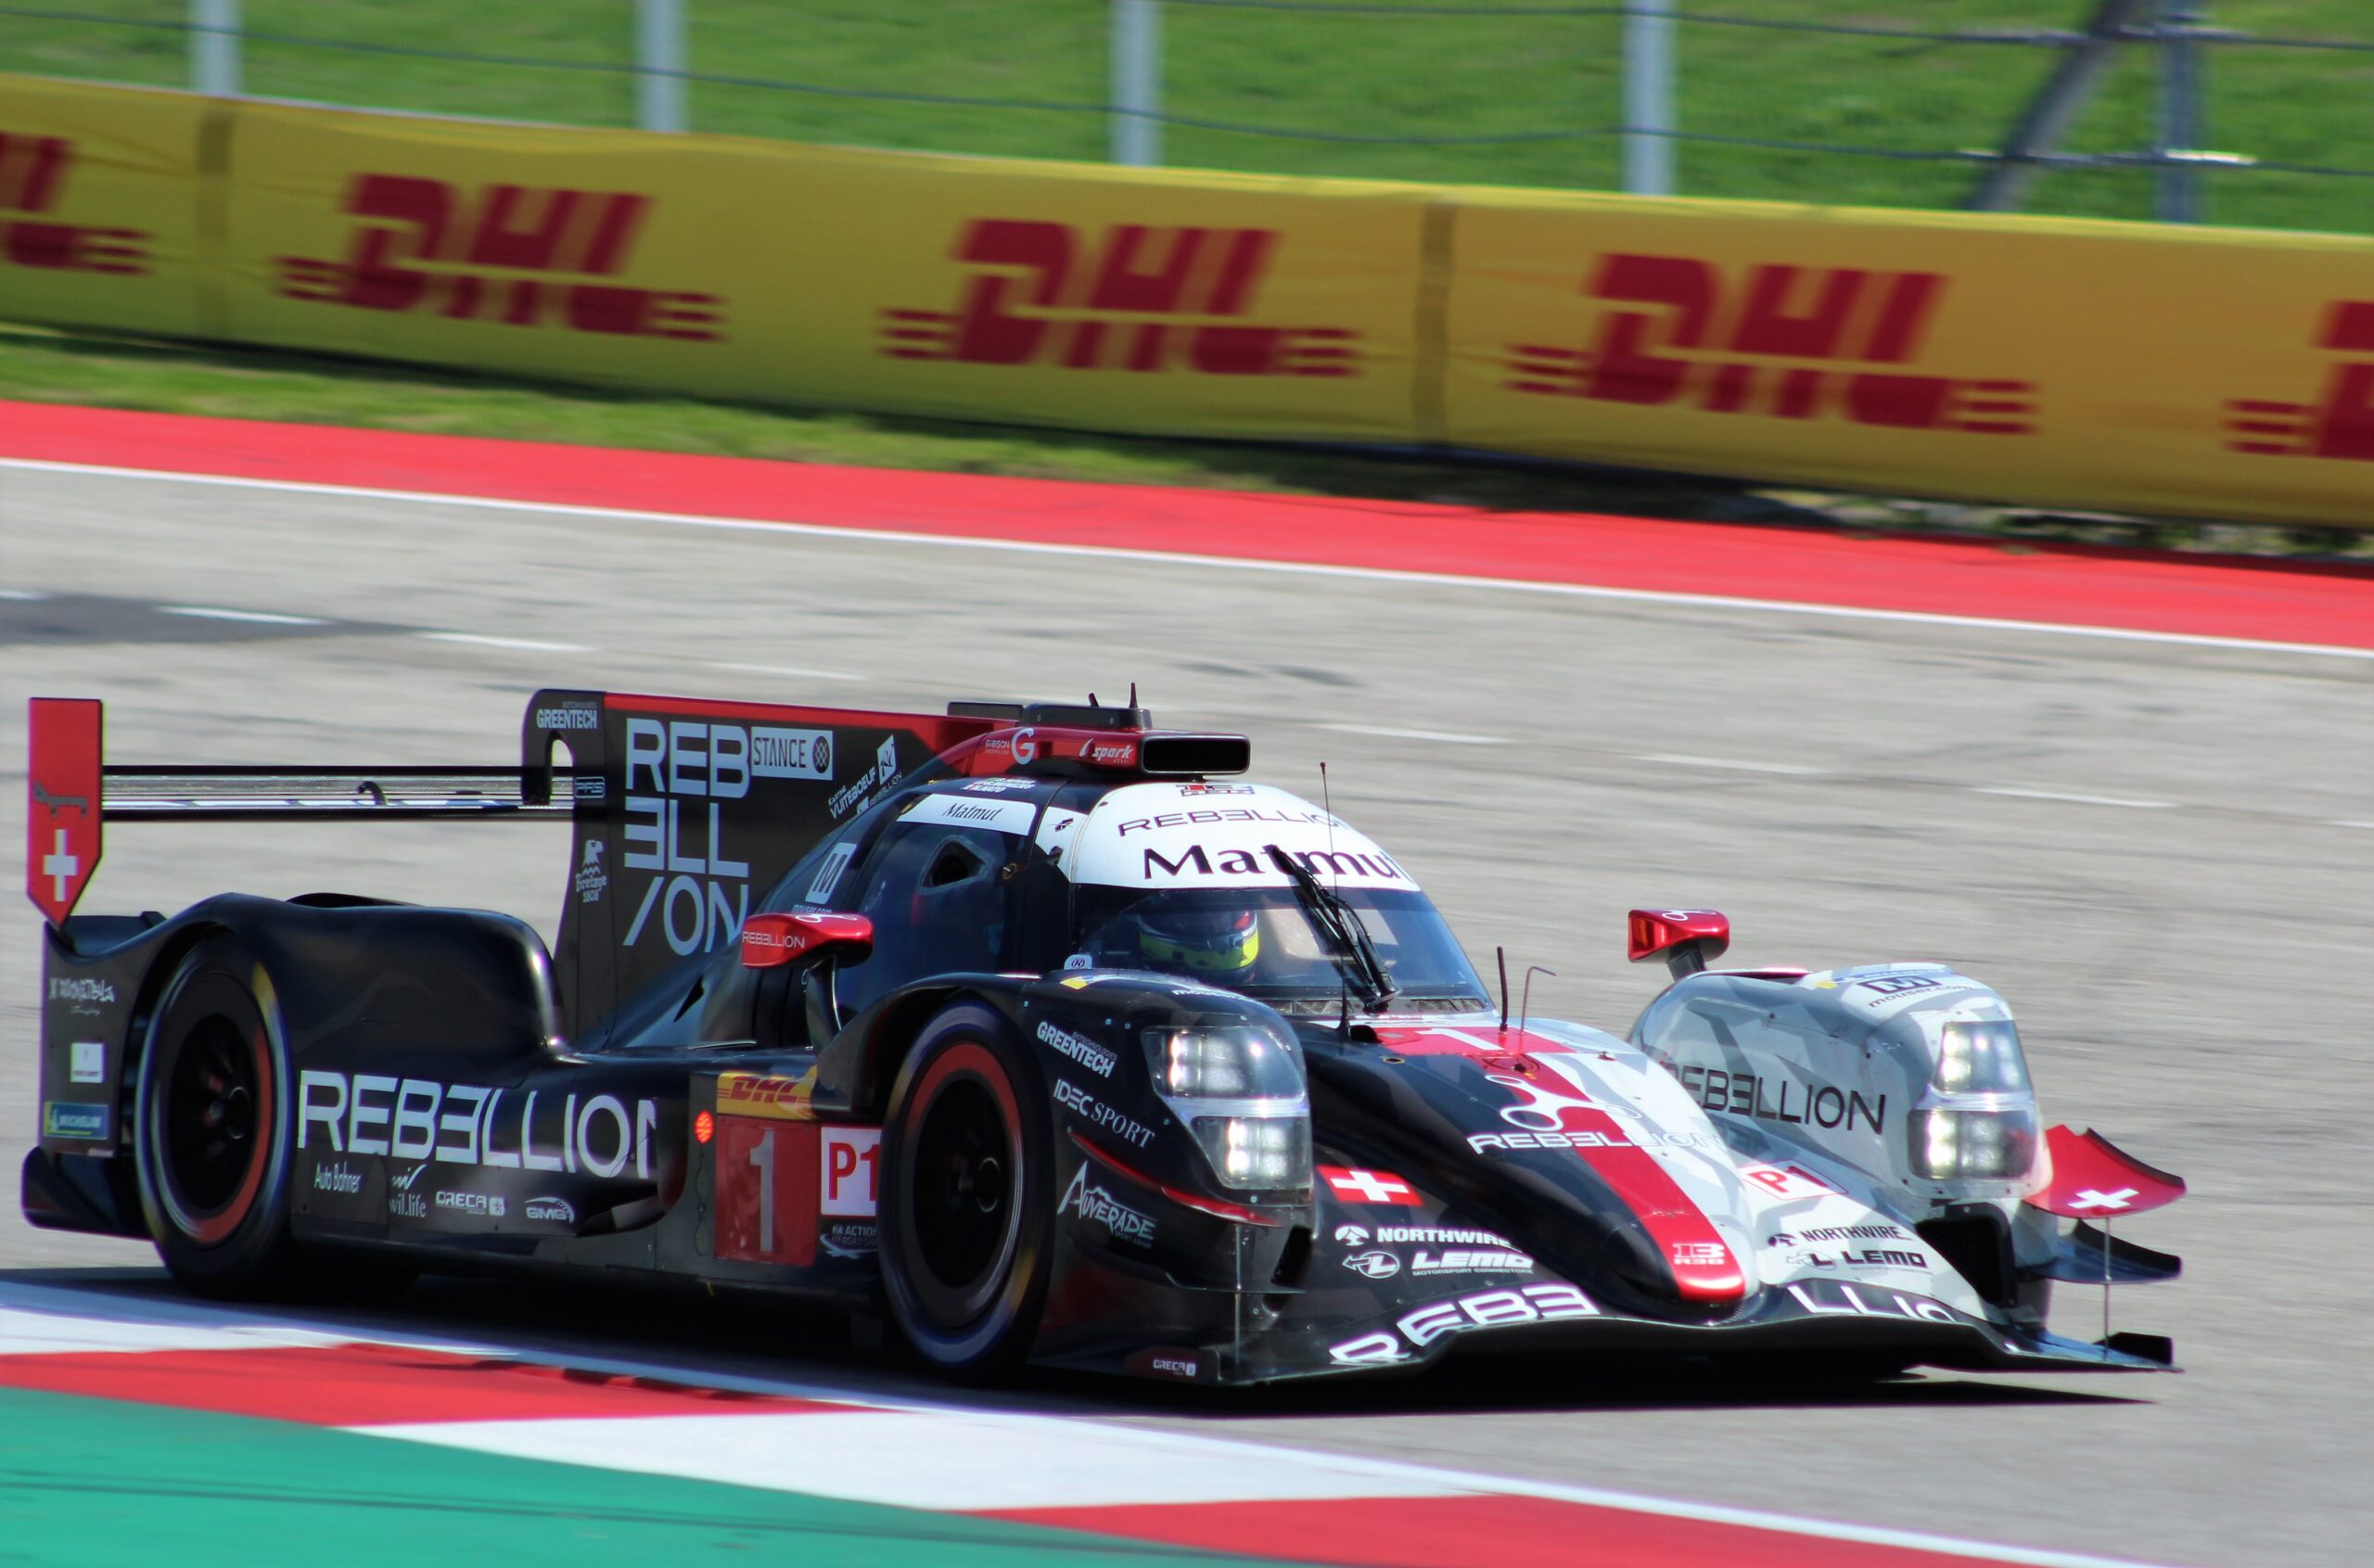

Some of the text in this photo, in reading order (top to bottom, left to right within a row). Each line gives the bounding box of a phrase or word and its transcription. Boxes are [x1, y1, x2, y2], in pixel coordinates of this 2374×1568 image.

[336, 172, 660, 338] DHL
[951, 217, 1295, 376] DHL
[1582, 251, 1959, 430] DHL
[536, 708, 597, 729] GREENTECH
[753, 737, 807, 768] STANCE
[985, 739, 1010, 748] GIBSON
[1092, 745, 1133, 761] spark
[941, 803, 1003, 821] Matmut
[1118, 809, 1350, 837] REBELLIO
[742, 931, 805, 949] REBELLION
[1869, 985, 1974, 1008] mouser.com
[1037, 1021, 1115, 1077] GREENTECH
[729, 1076, 798, 1103] DHL
[1666, 1063, 1887, 1136] EBELLION
[1053, 1078, 1155, 1148] IDEC SPORT
[828, 1141, 880, 1202] P1
[749, 1127, 775, 1252] 1
[1799, 1225, 1902, 1243] NORTHWIRE
[1411, 1252, 1534, 1269] LEMO
[1841, 1250, 1930, 1268] LEMO
